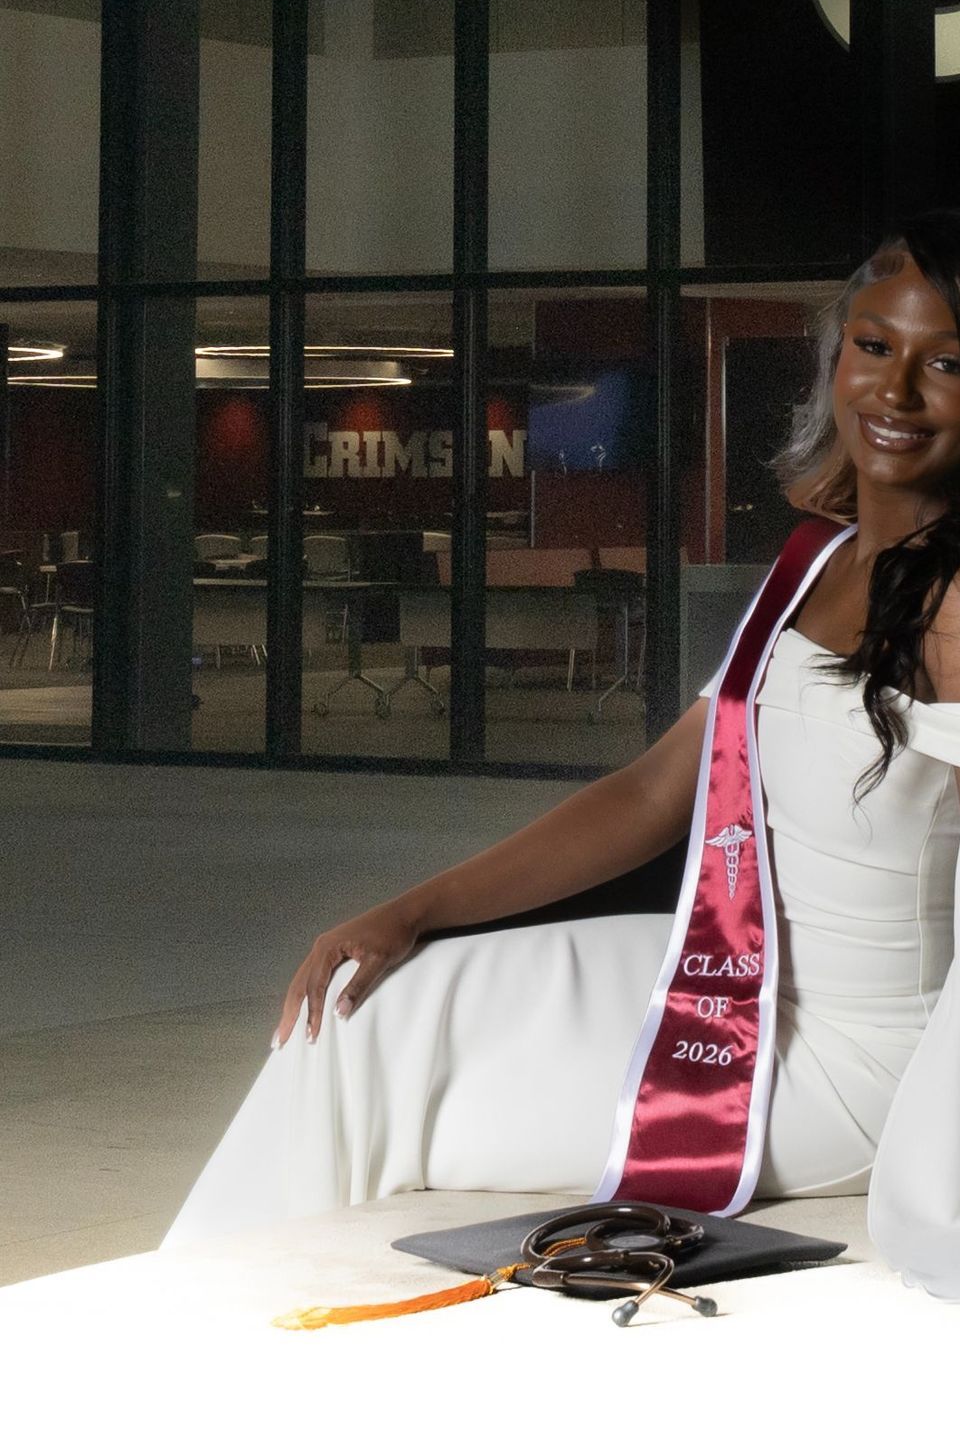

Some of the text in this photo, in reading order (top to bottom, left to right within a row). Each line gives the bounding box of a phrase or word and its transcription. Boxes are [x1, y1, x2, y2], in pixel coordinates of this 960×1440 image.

[303, 423, 526, 477] CRIMSN
[683, 953, 761, 978] CLASS
[696, 995, 730, 1018] OF
[672, 1040, 733, 1066] 2026
